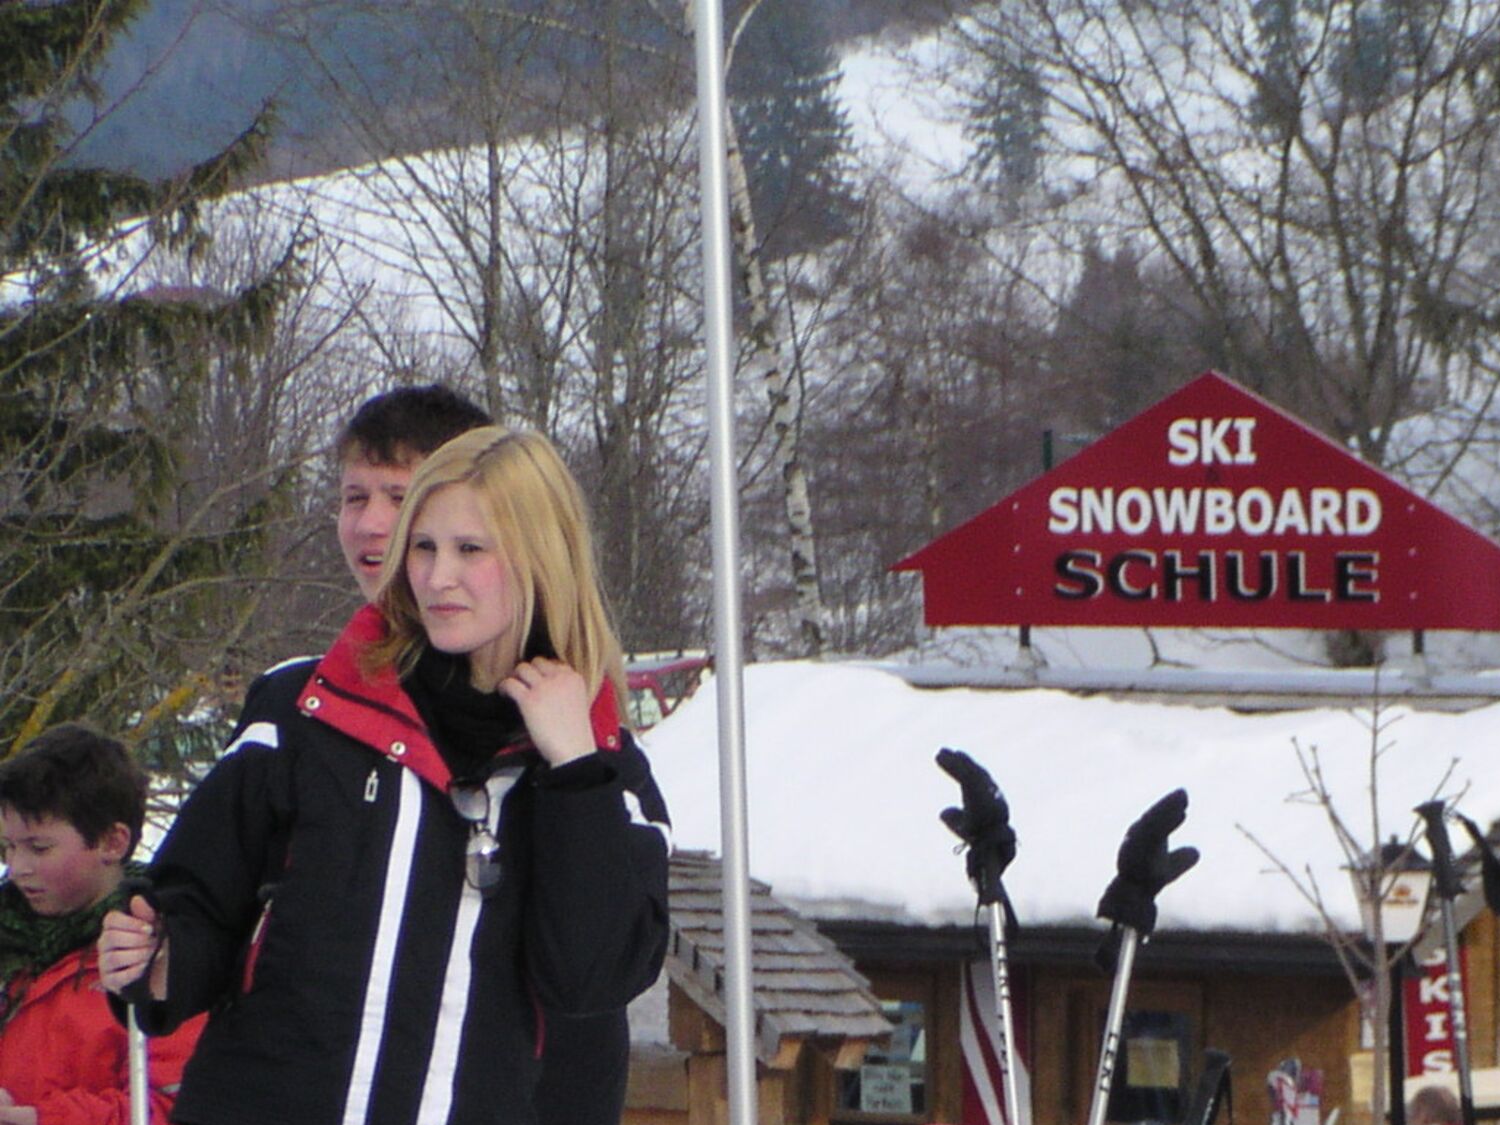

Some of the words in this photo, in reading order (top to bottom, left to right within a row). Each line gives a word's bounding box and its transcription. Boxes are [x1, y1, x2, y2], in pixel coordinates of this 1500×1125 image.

[1168, 417, 1256, 466] SKI
[1048, 486, 1382, 536] SNOWBOARD
[1053, 549, 1381, 603] SCHULE
